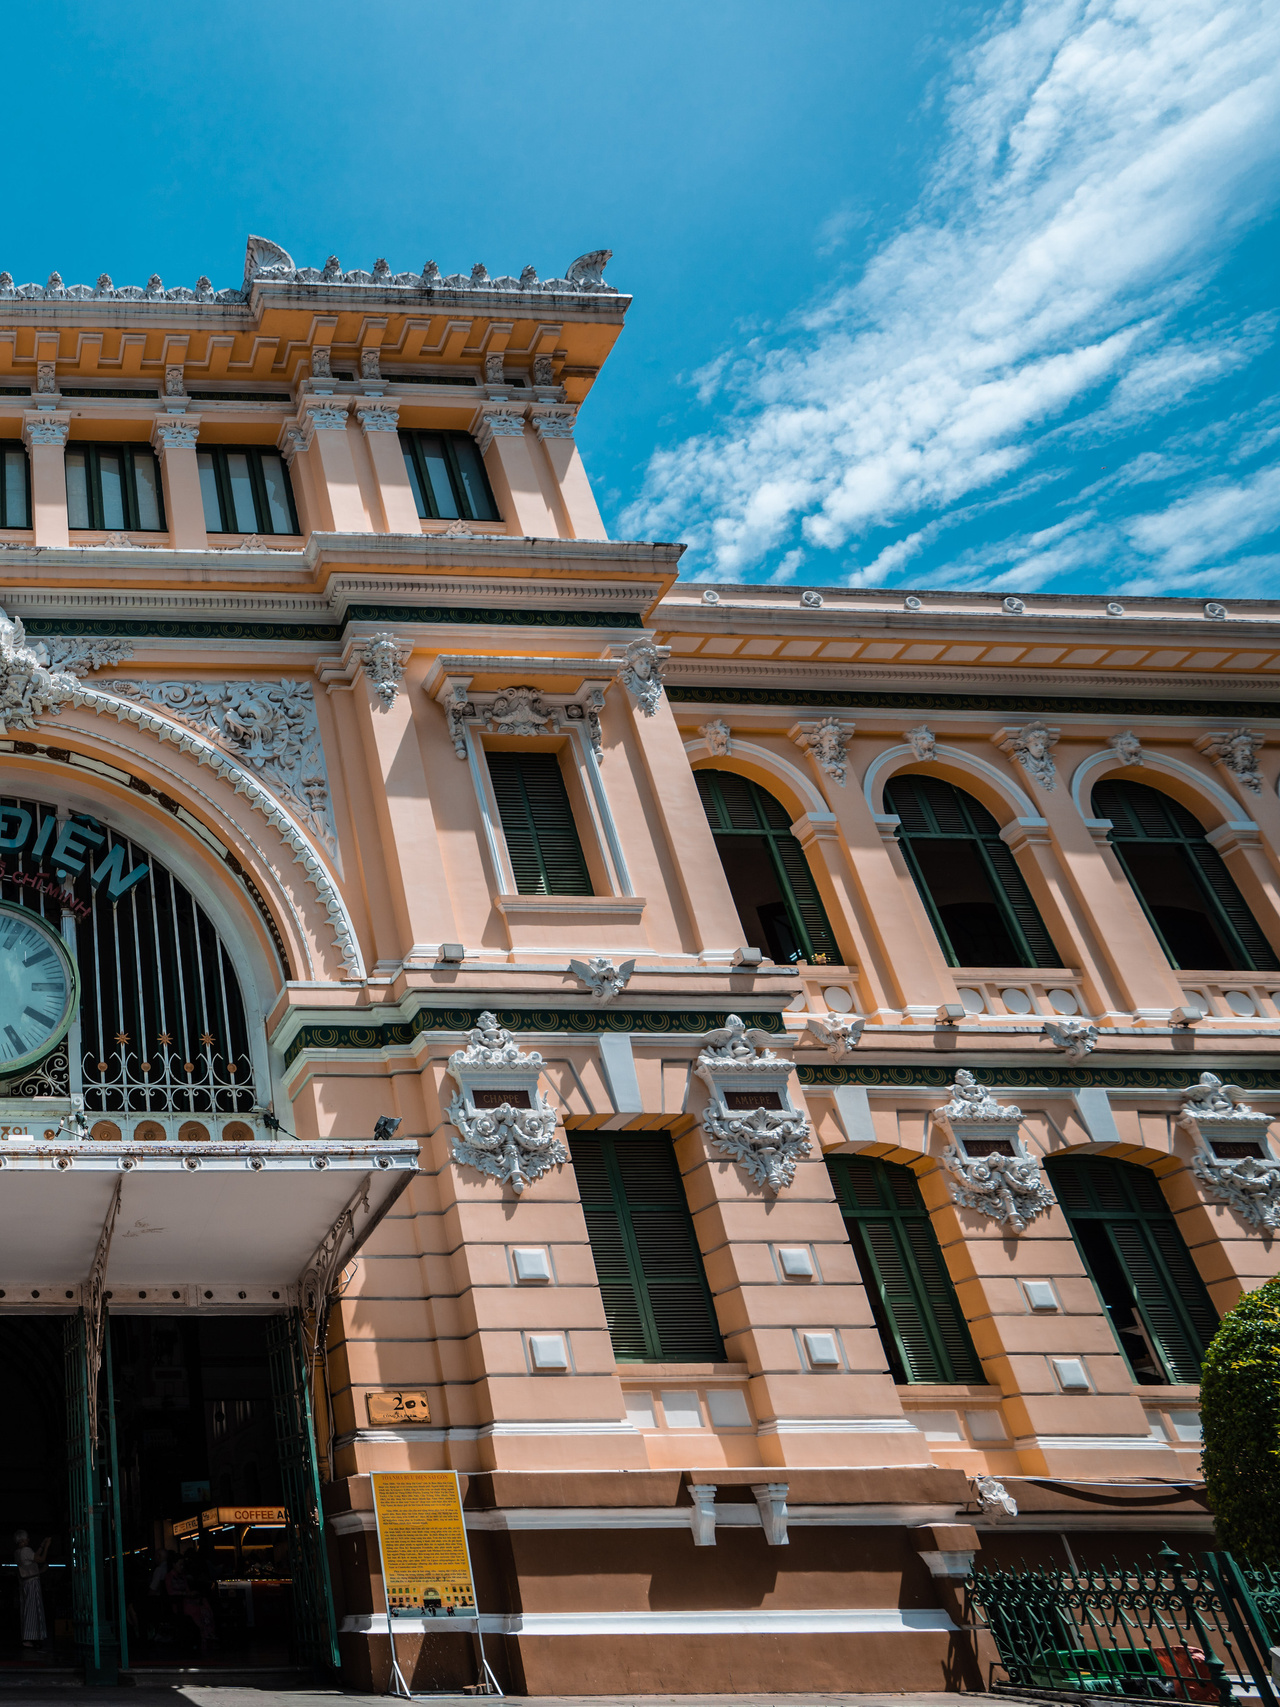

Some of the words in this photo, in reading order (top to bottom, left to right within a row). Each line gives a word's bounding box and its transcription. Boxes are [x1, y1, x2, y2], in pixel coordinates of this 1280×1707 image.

[12, 871, 50, 892] CHÍ
[45, 882, 92, 918] MINH
[483, 1094, 520, 1104] CHAPPE
[234, 1510, 275, 1520] COFFEE
